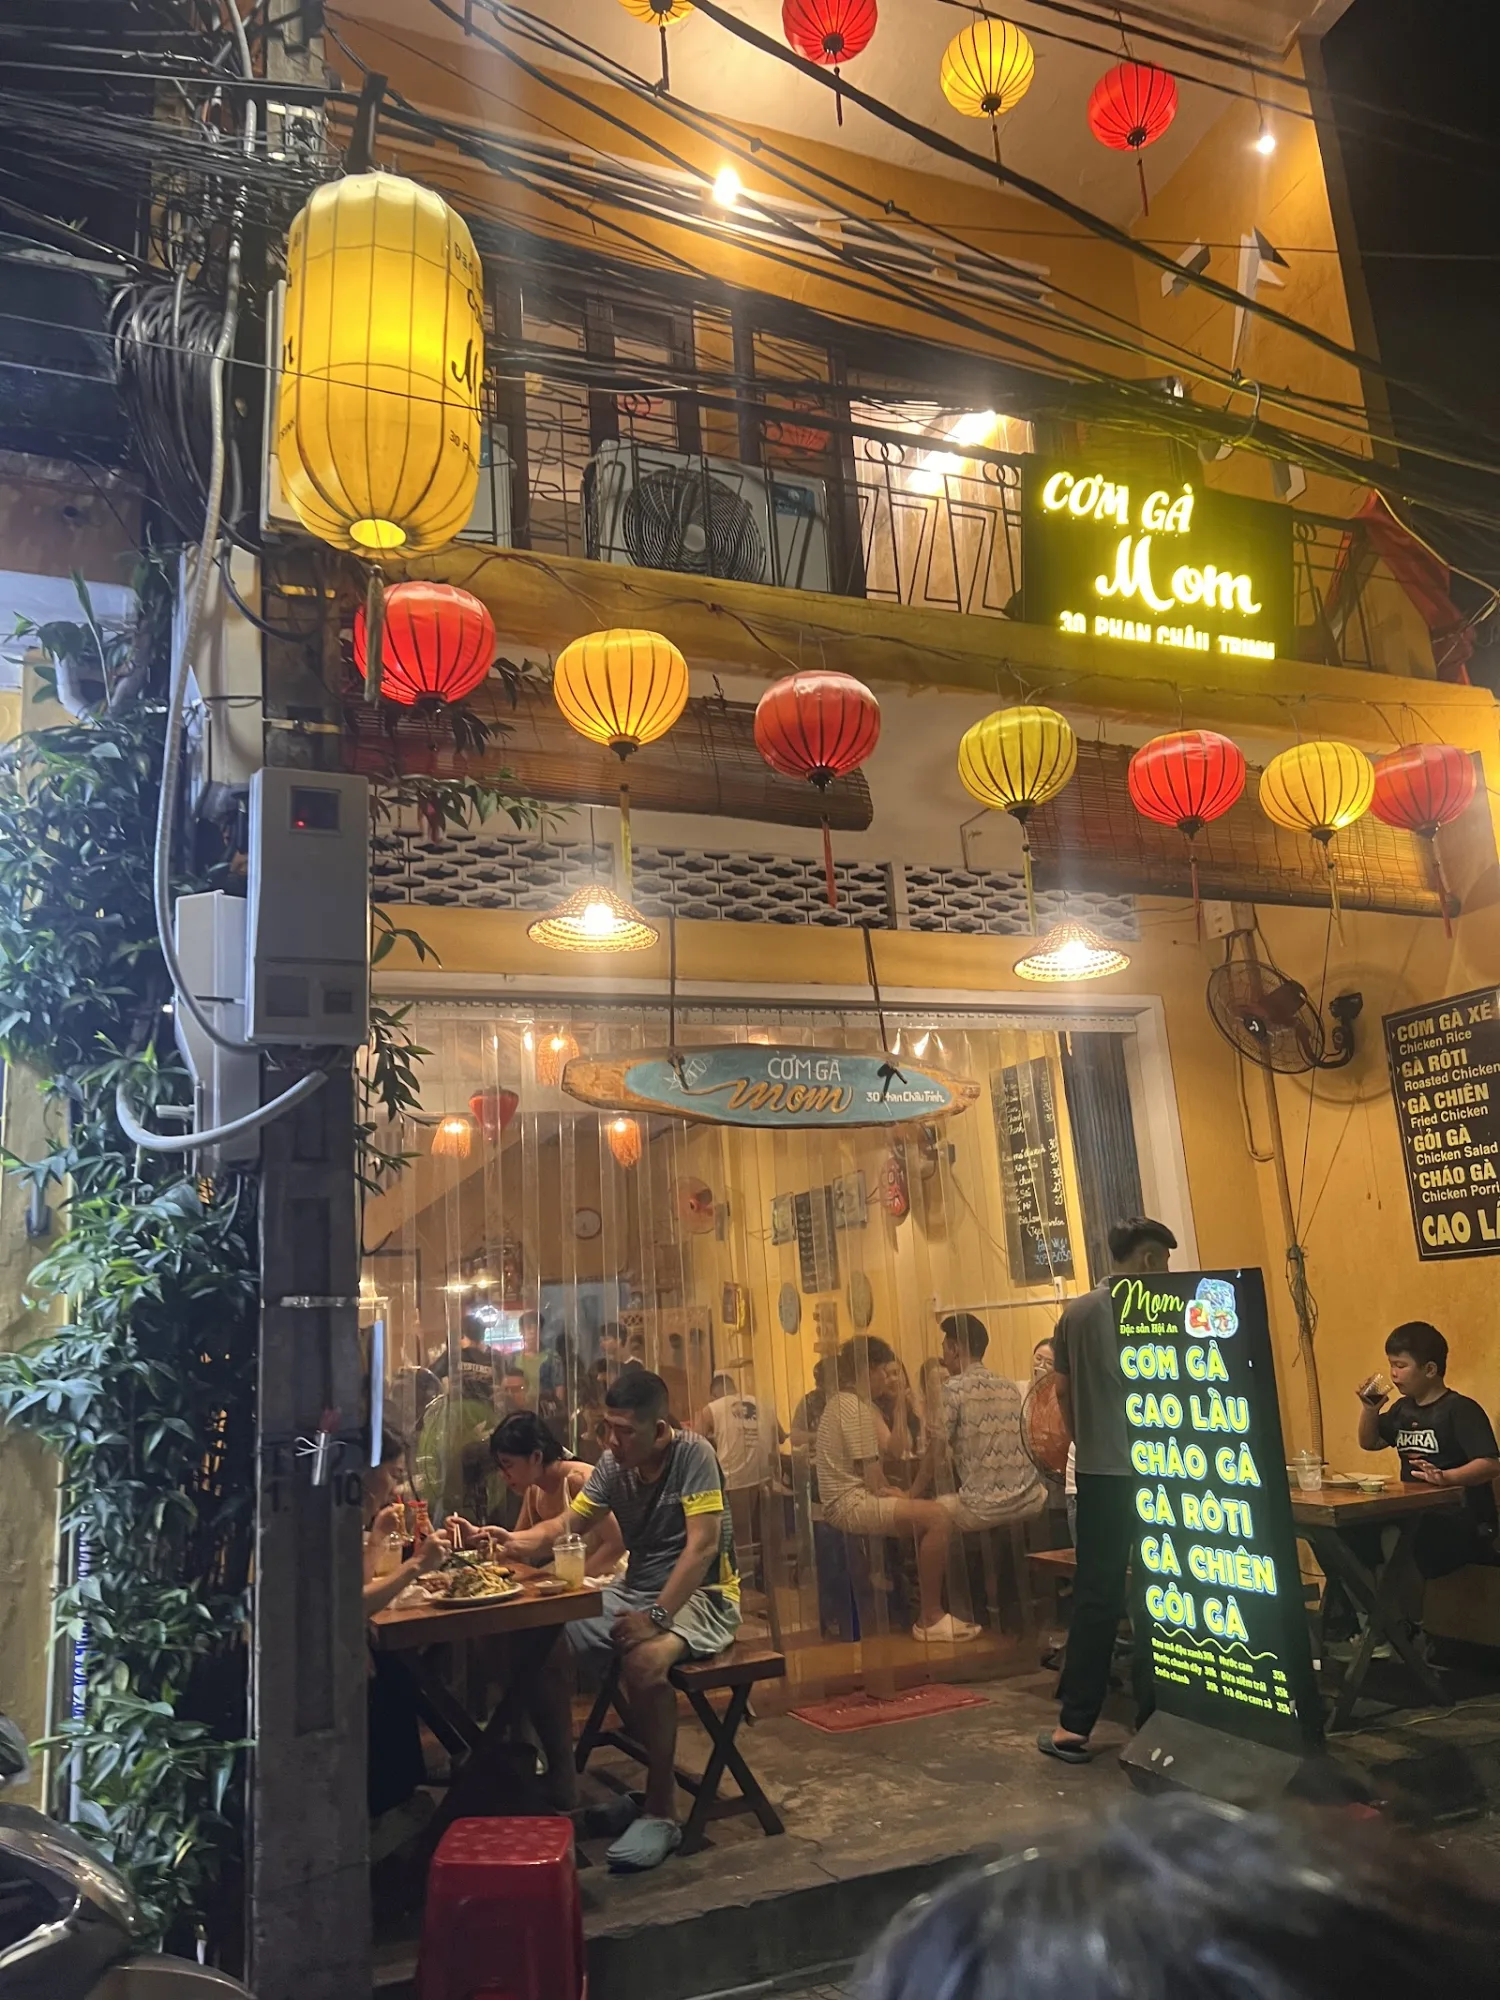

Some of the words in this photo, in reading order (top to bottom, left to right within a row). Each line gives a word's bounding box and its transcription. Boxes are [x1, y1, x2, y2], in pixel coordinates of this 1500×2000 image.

[1043, 471, 1129, 525] CƠM
[1141, 483, 1195, 533] GÀ
[1095, 535, 1262, 614] Mom
[1095, 616, 1152, 642] PHAN
[1397, 1017, 1435, 1042] CƠM
[1439, 1008, 1464, 1032] GÀ
[1467, 1000, 1493, 1024] XÉ
[1399, 1037, 1443, 1056] Chicken
[1445, 1030, 1472, 1045] Rice
[768, 1054, 811, 1080] CƠM
[1401, 1056, 1425, 1078] GÀ
[1428, 1048, 1468, 1073] RÔTI
[1404, 1072, 1449, 1092] Roasted
[1451, 1062, 1500, 1082] Chicken
[866, 1091, 880, 1103] 30
[881, 1091, 902, 1103] han
[1407, 1092, 1431, 1115] GÀ
[1433, 1082, 1490, 1109] CHIÊN
[1410, 1113, 1438, 1129] Fried
[1440, 1105, 1489, 1123] Chicken
[1413, 1128, 1442, 1152] GỎI
[1446, 1124, 1472, 1147] GÀ
[1416, 1150, 1461, 1166] Chicken
[1464, 1141, 1499, 1158] Salad
[1419, 1165, 1466, 1189] CHÁO
[1470, 1159, 1497, 1182] GÀ
[1422, 1188, 1468, 1203] Chicken
[1422, 1211, 1471, 1247] CAO
[1112, 1279, 1184, 1323] Mom
[1151, 1323, 1165, 1335] Hội
[1166, 1324, 1178, 1333] An
[1120, 1343, 1179, 1380] CƠM
[1185, 1339, 1229, 1381] GÀ
[1126, 1393, 1183, 1429] CAO
[1190, 1387, 1250, 1433] LẦU
[1398, 1433, 1435, 1449] AKIRA
[1215, 1442, 1262, 1486] GÀ
[1136, 1484, 1176, 1527] GÀ
[1181, 1490, 1253, 1538] RÔTI
[1141, 1533, 1181, 1576] GÀ
[1188, 1545, 1278, 1595] CHIÊN
[1203, 1595, 1249, 1642] GÀ
